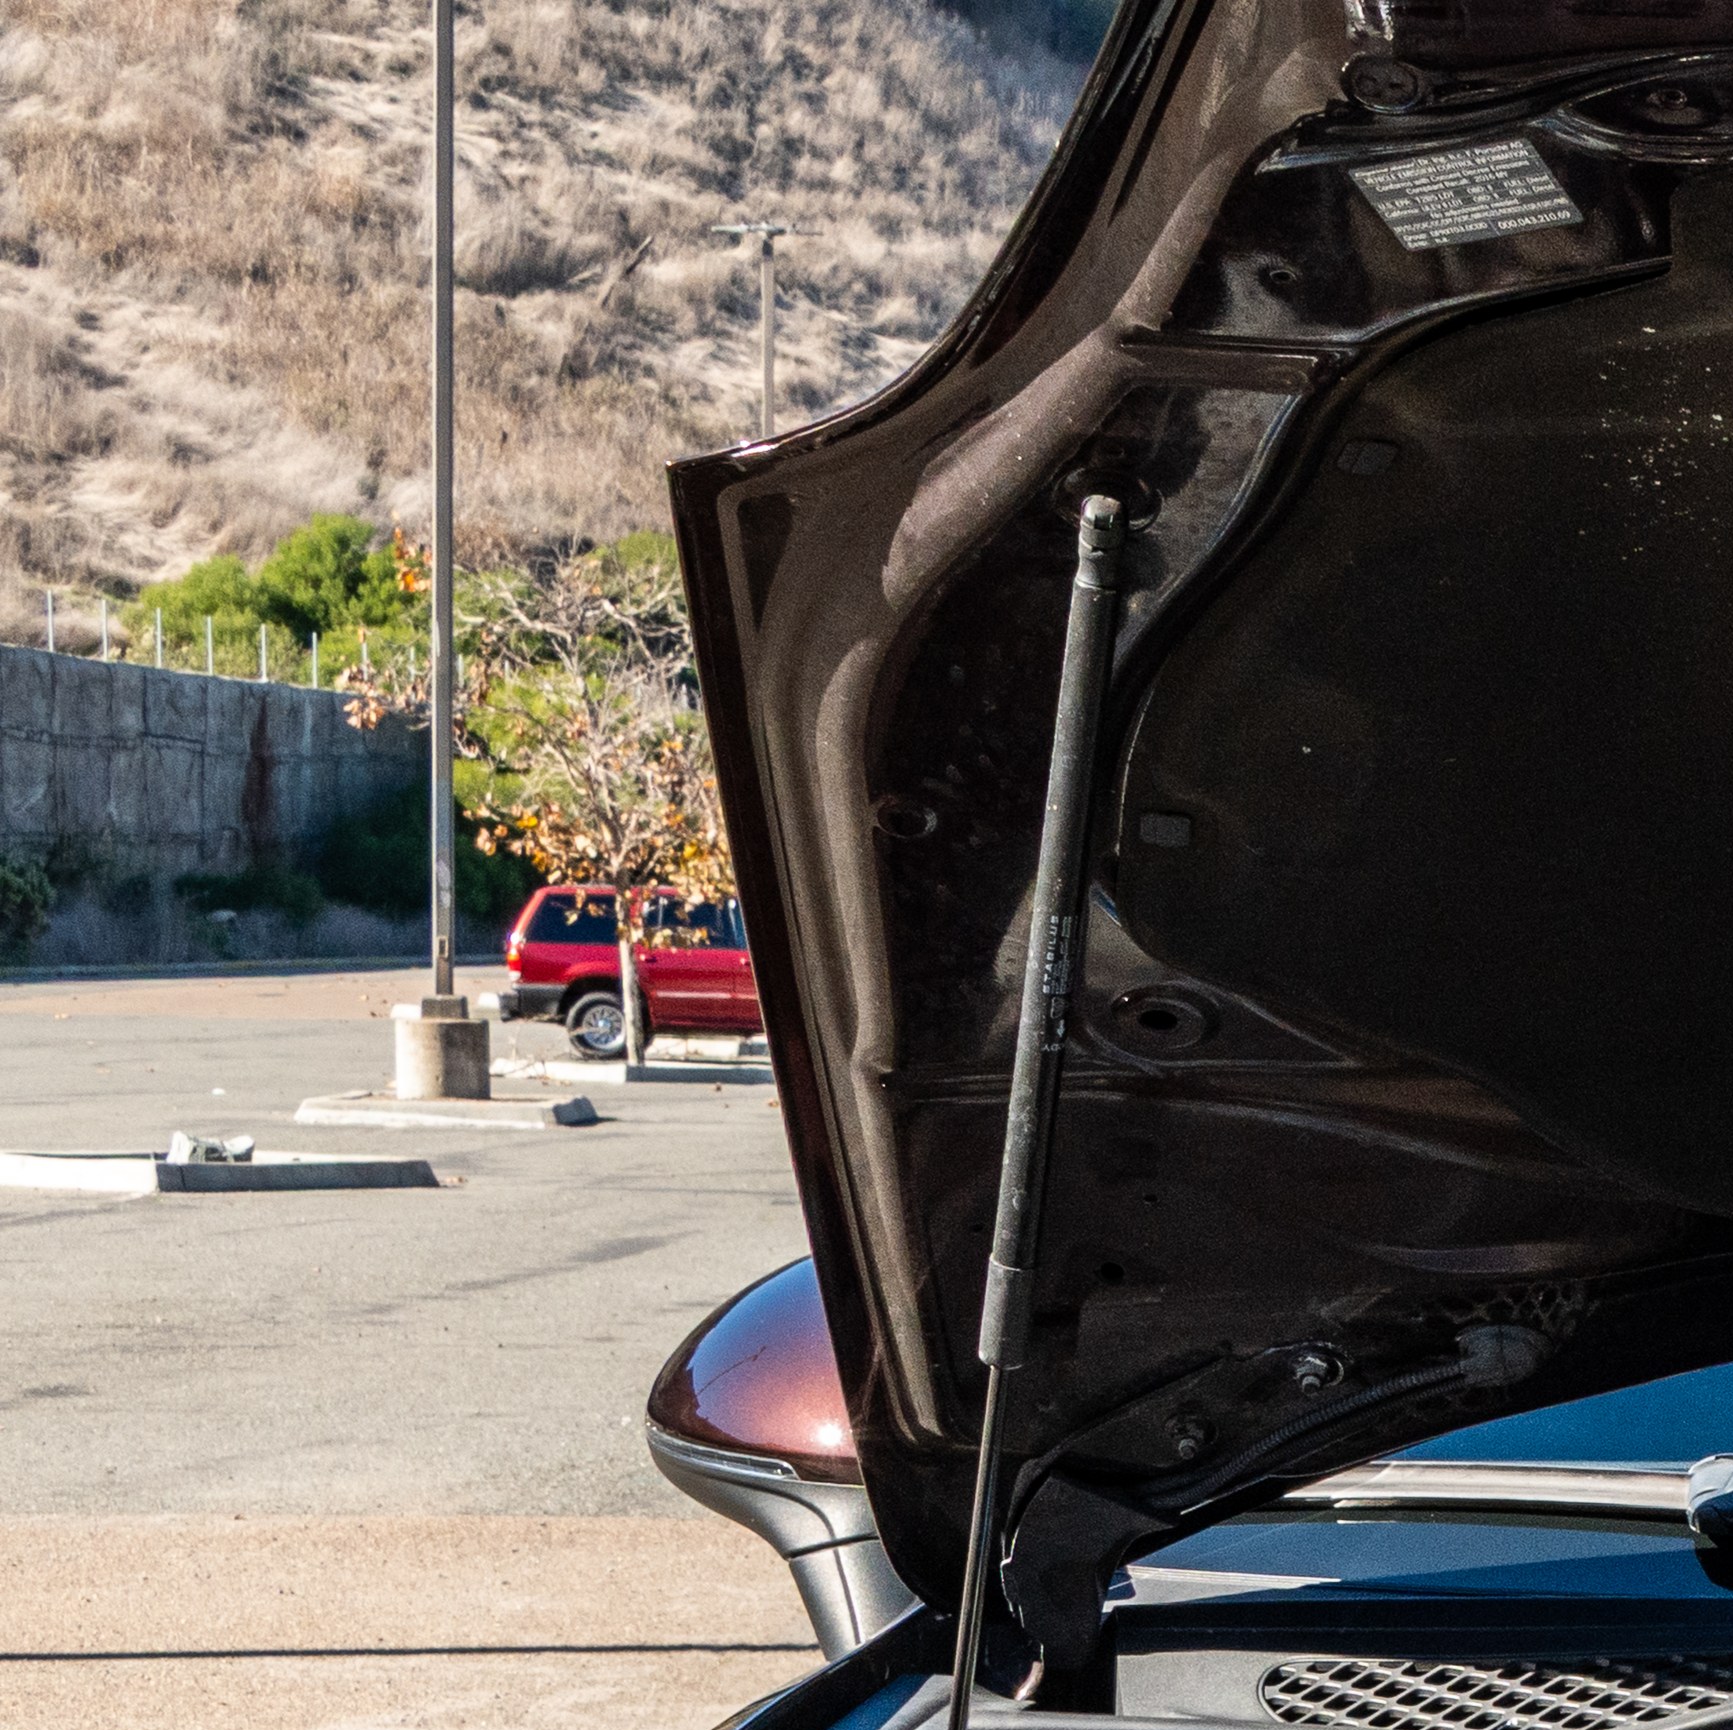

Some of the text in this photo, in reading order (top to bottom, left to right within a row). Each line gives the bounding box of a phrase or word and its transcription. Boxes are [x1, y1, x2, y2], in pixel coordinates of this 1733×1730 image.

[1473, 143, 1509, 155] Porsche
[1507, 141, 1524, 149] AG
[1435, 159, 1474, 172] CONTROL
[1473, 149, 1529, 165] INFORMATION
[1412, 177, 1430, 185] with
[1472, 173, 1496, 182] 2016
[1524, 173, 1550, 183] Diesel
[1530, 181, 1555, 191] Diesel
